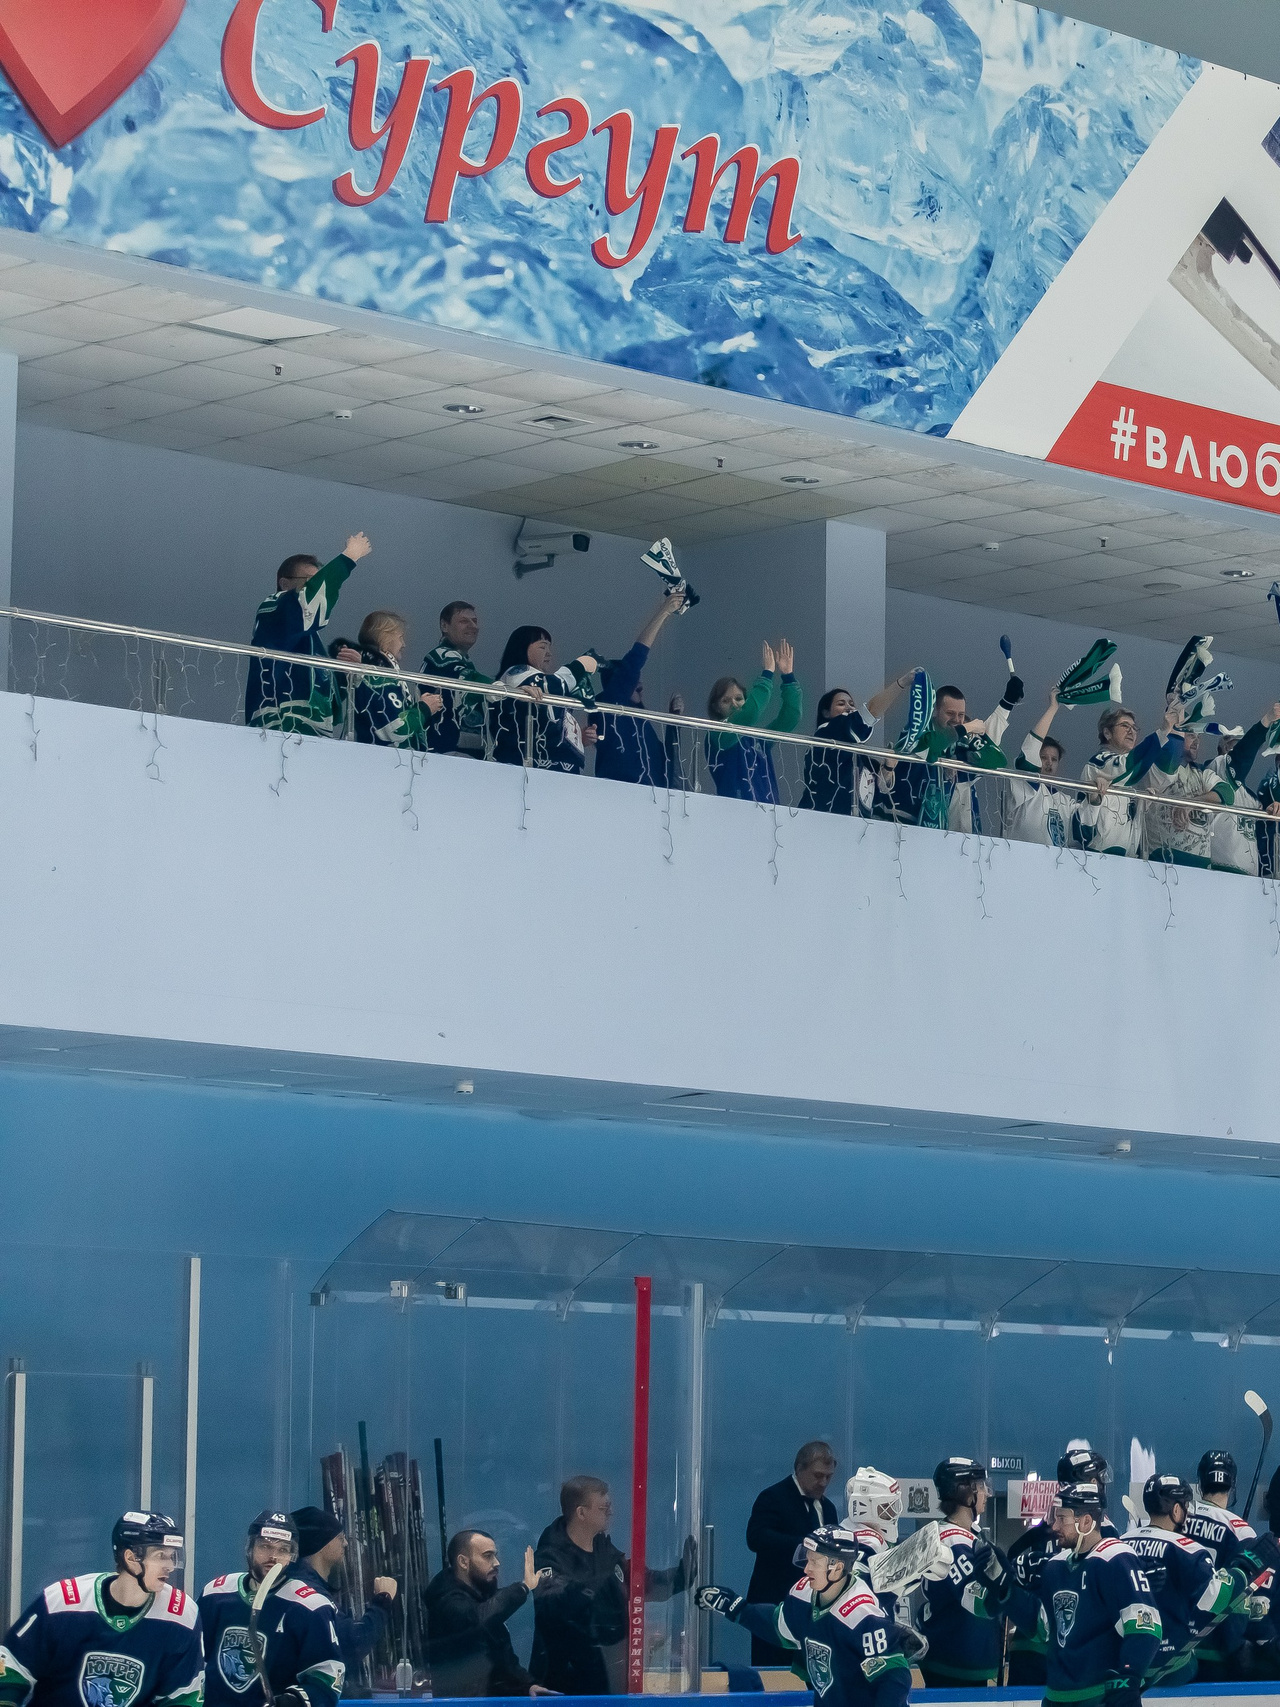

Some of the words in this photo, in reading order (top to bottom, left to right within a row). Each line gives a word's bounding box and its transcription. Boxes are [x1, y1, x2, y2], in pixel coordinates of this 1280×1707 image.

[221, 0, 803, 270] Сургут
[991, 1457, 1022, 1470] ВЫХОД
[1213, 1471, 1225, 1483] 18
[272, 1513, 287, 1522] 43
[1126, 1540, 1167, 1559] RISHIN
[948, 1554, 974, 1585] 96
[1081, 1570, 1087, 1590] C
[1129, 1569, 1151, 1592] 15
[275, 1613, 286, 1633] A
[862, 1627, 889, 1657] 98
[87, 1660, 141, 1685] ЮГРА
